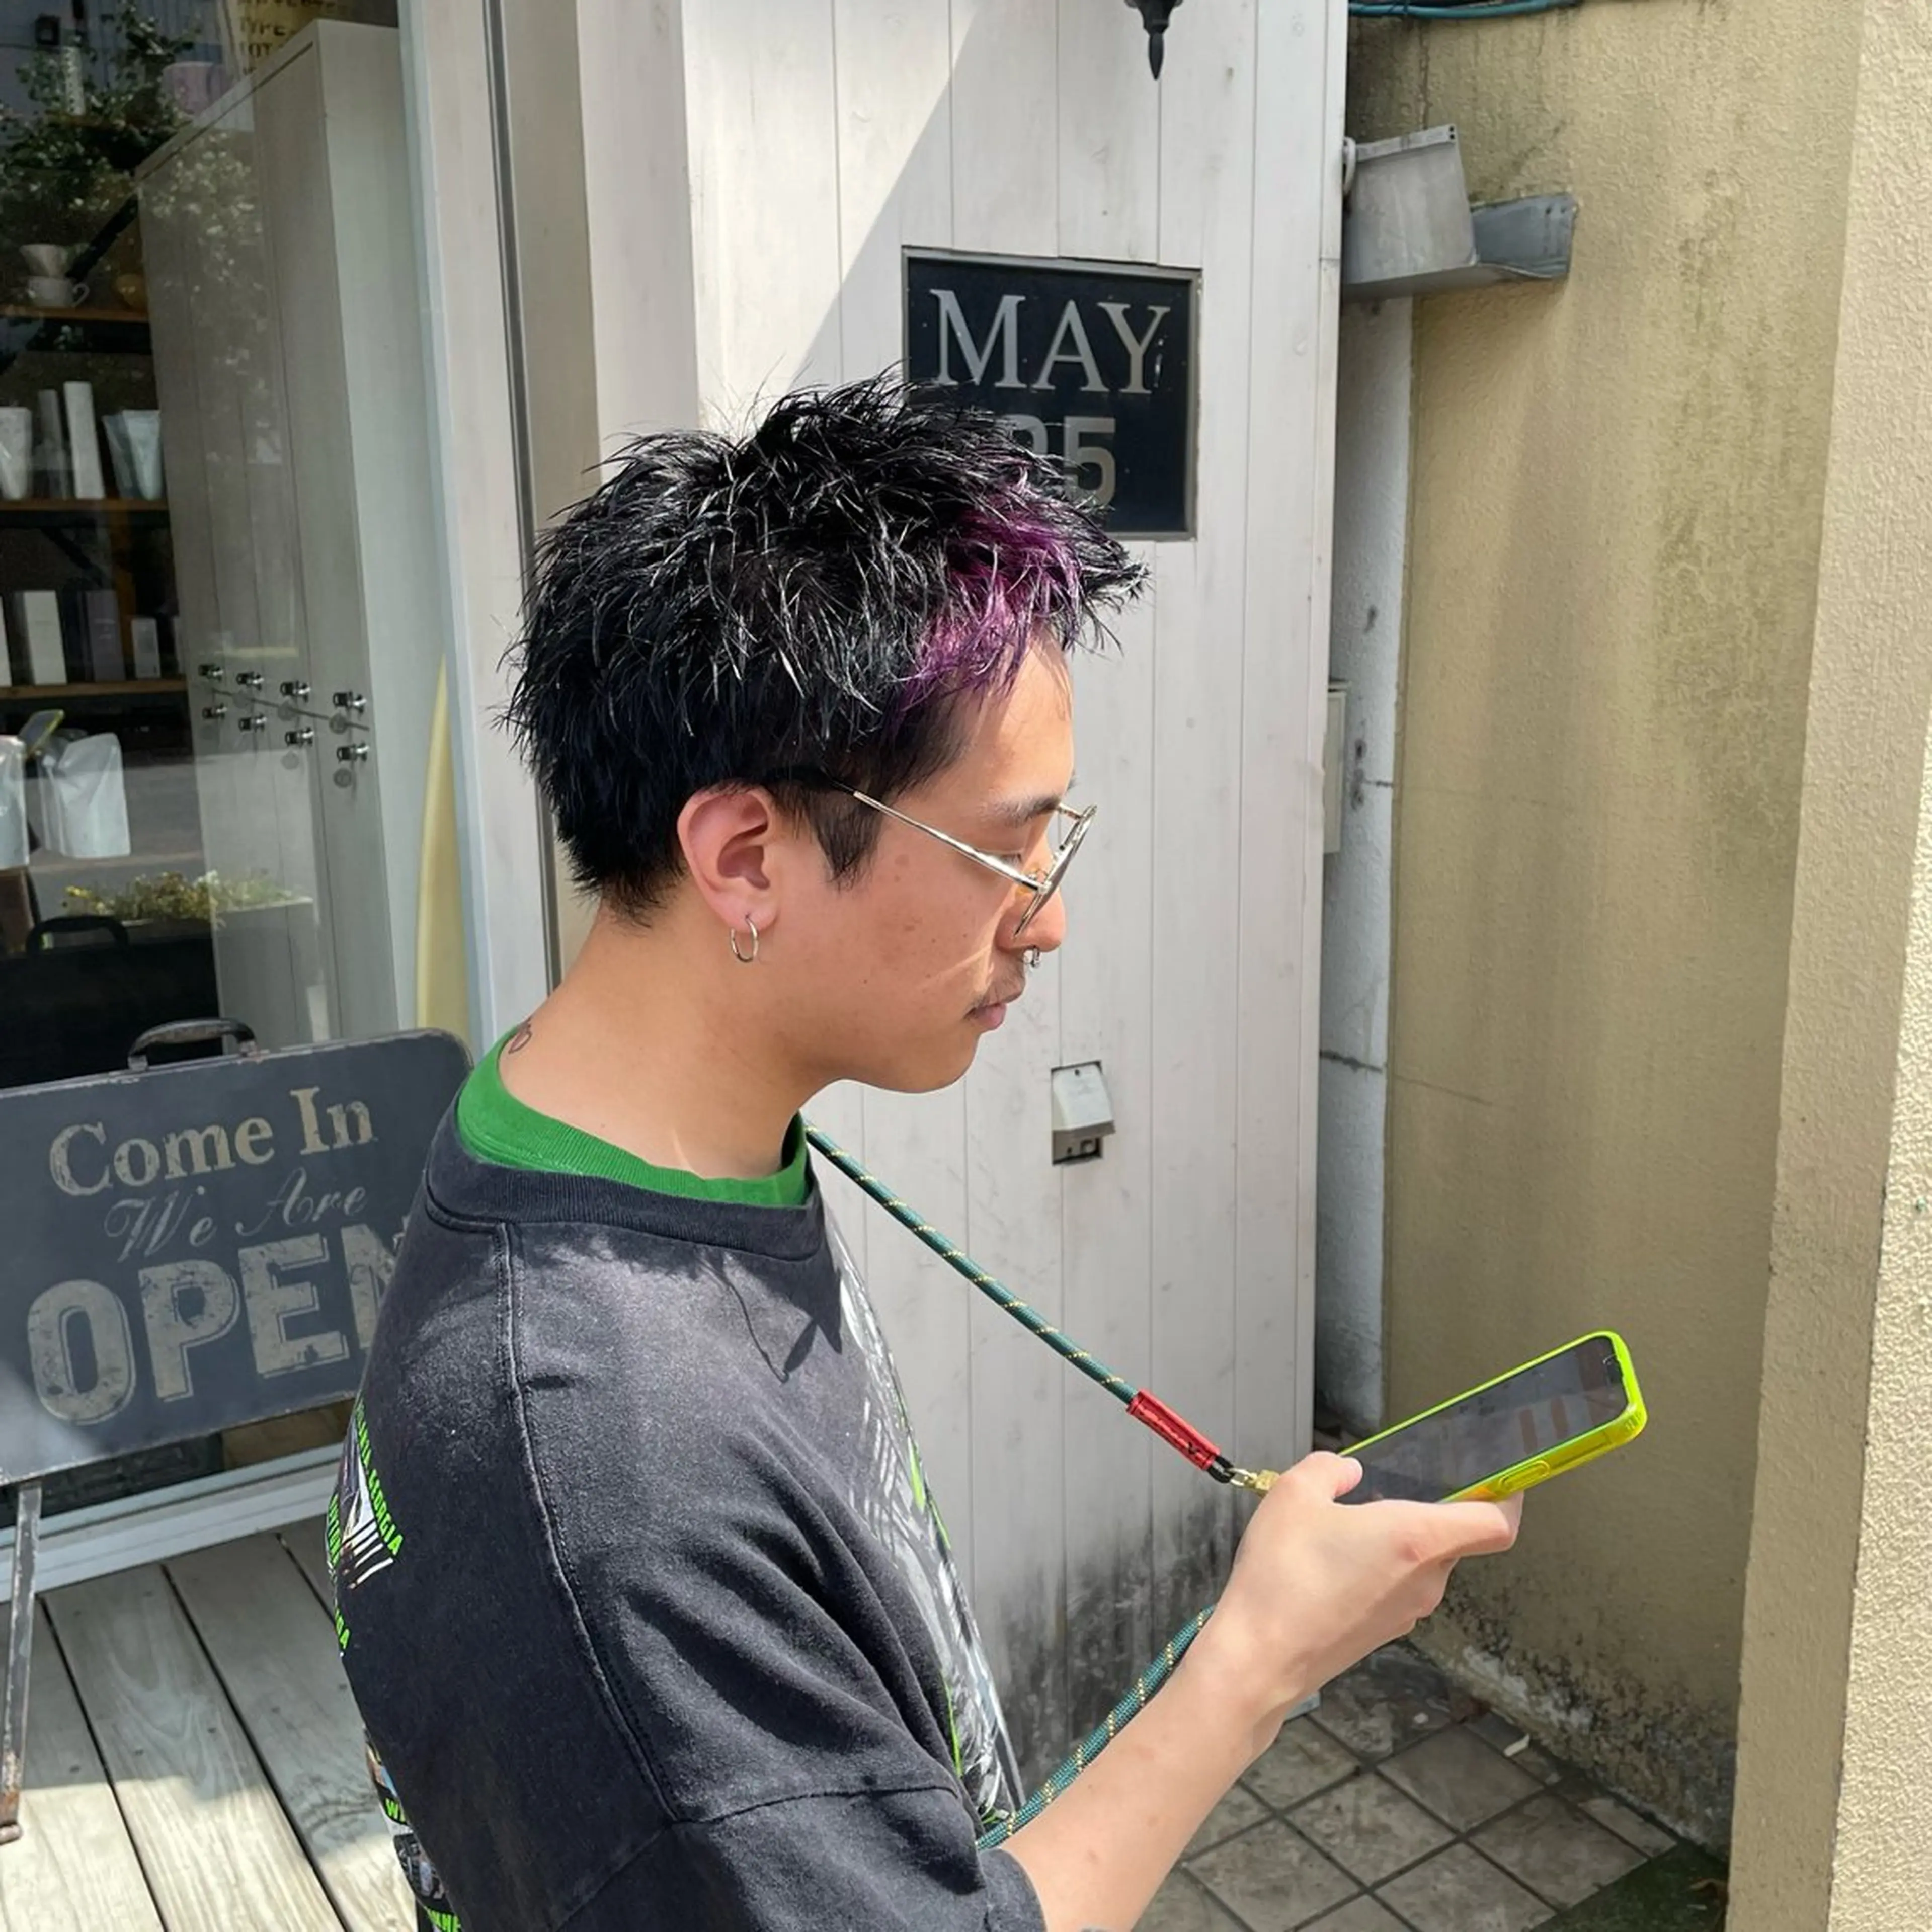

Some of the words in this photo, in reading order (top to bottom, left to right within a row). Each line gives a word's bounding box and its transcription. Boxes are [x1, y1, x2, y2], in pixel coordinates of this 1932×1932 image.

[929, 288, 1171, 394] MAY
[49, 1116, 275, 1196] Come
[290, 1086, 376, 1156] In
[104, 1185, 217, 1263] We
[235, 1167, 368, 1237] Are
